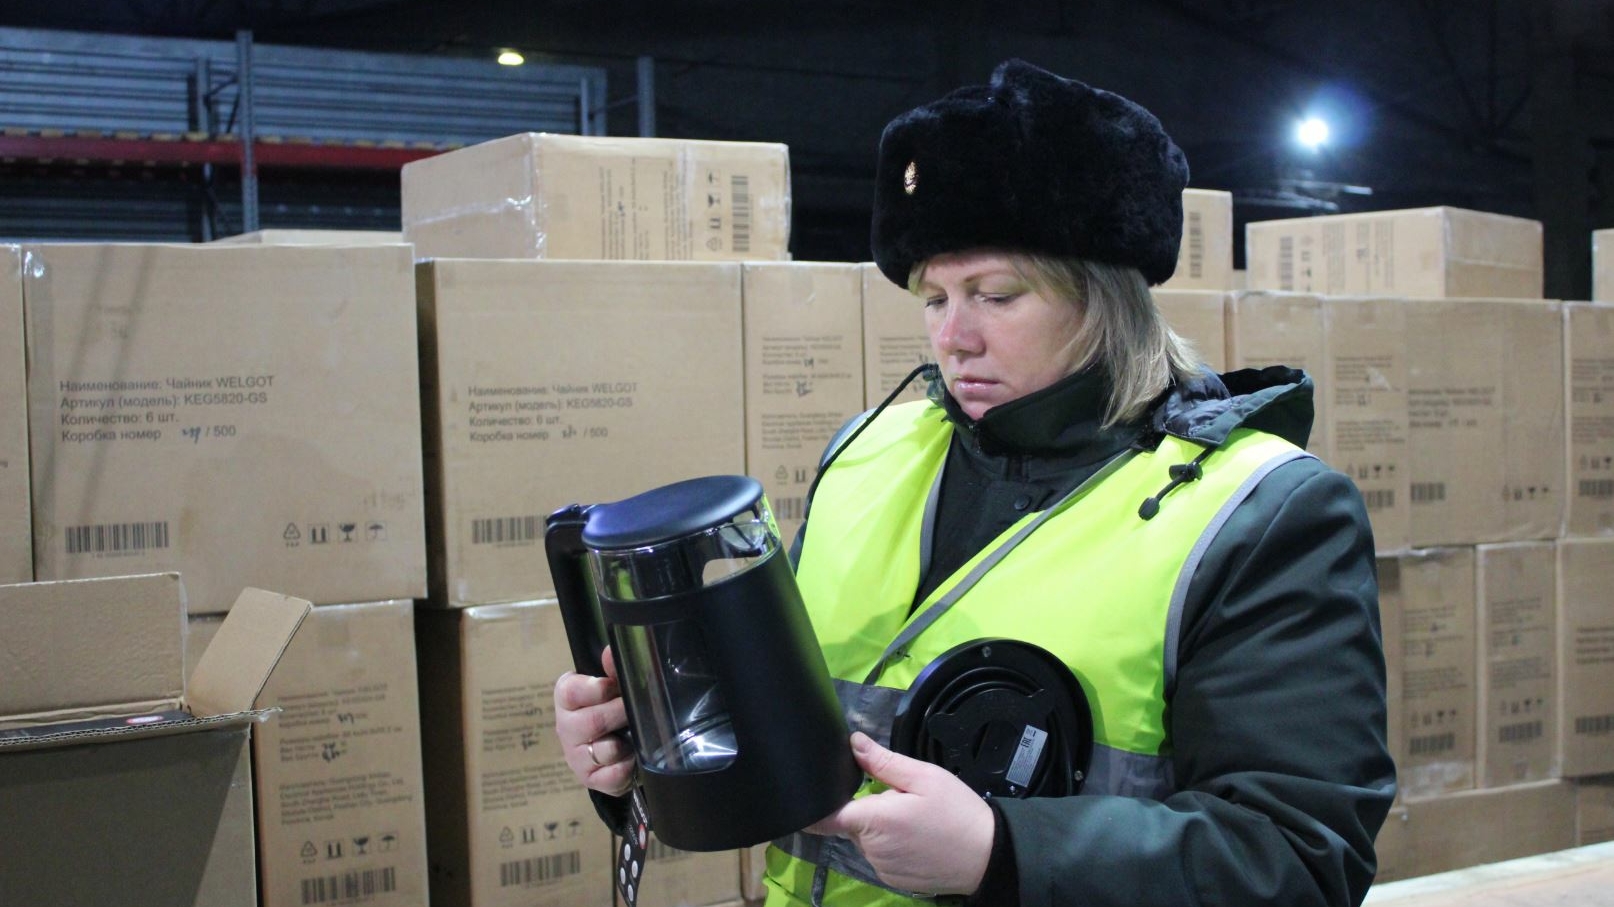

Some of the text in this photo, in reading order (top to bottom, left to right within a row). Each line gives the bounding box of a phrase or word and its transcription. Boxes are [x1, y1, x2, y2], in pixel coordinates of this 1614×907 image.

[60, 375, 275, 392] Наименование: Чайник WELGOT
[61, 392, 267, 409] Артикул (модель): KEG5820-GS
[469, 401, 512, 413] Артикул
[61, 412, 179, 425] Количество: 6 шт.
[62, 429, 116, 443] Коробка
[121, 429, 161, 441] номер
[214, 425, 236, 437] 500
[470, 431, 513, 443] Коробка
[516, 431, 549, 440] номер
